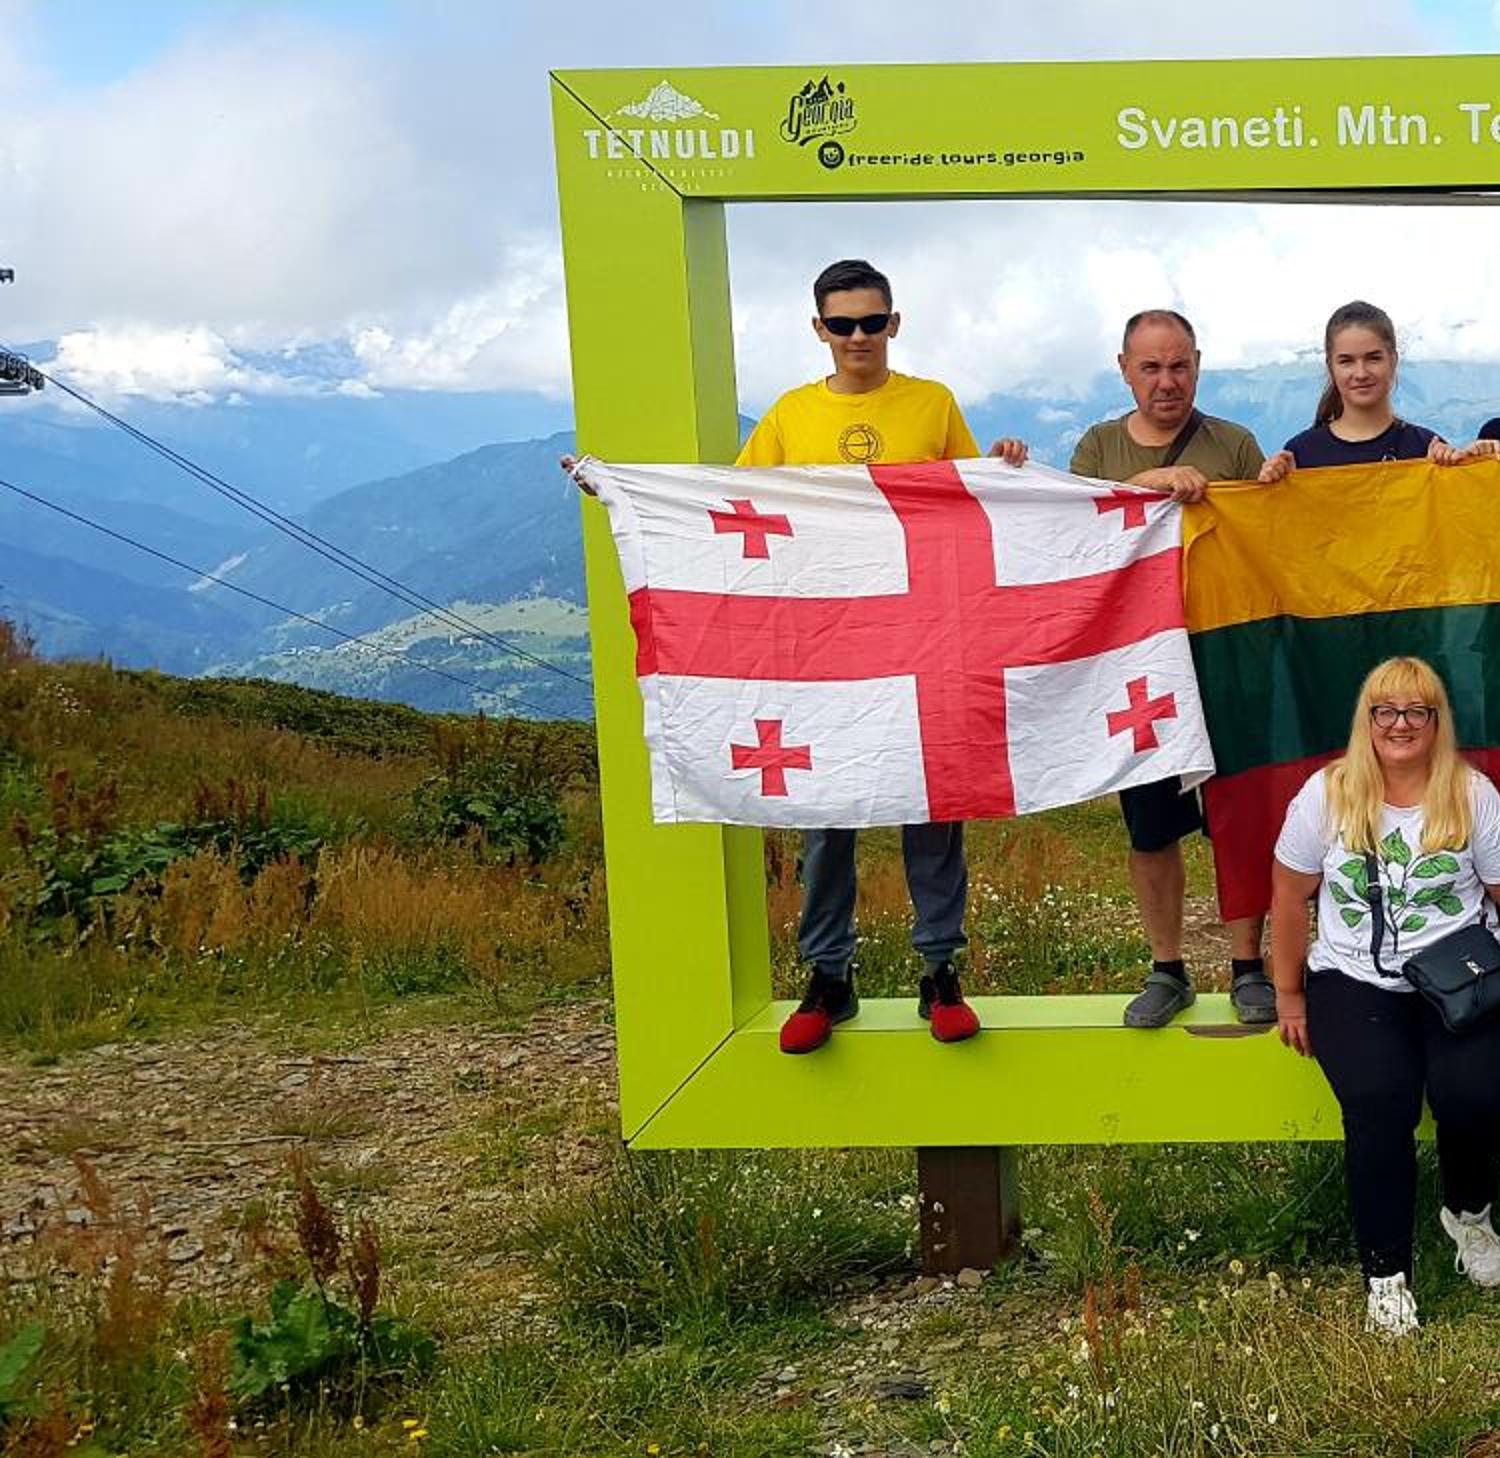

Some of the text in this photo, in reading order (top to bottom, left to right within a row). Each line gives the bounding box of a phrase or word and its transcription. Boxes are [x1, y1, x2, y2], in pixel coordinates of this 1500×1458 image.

[583, 129, 755, 159] TETNULDI
[1116, 106, 1318, 149] Svaneti.
[1336, 104, 1443, 146] Mtn.
